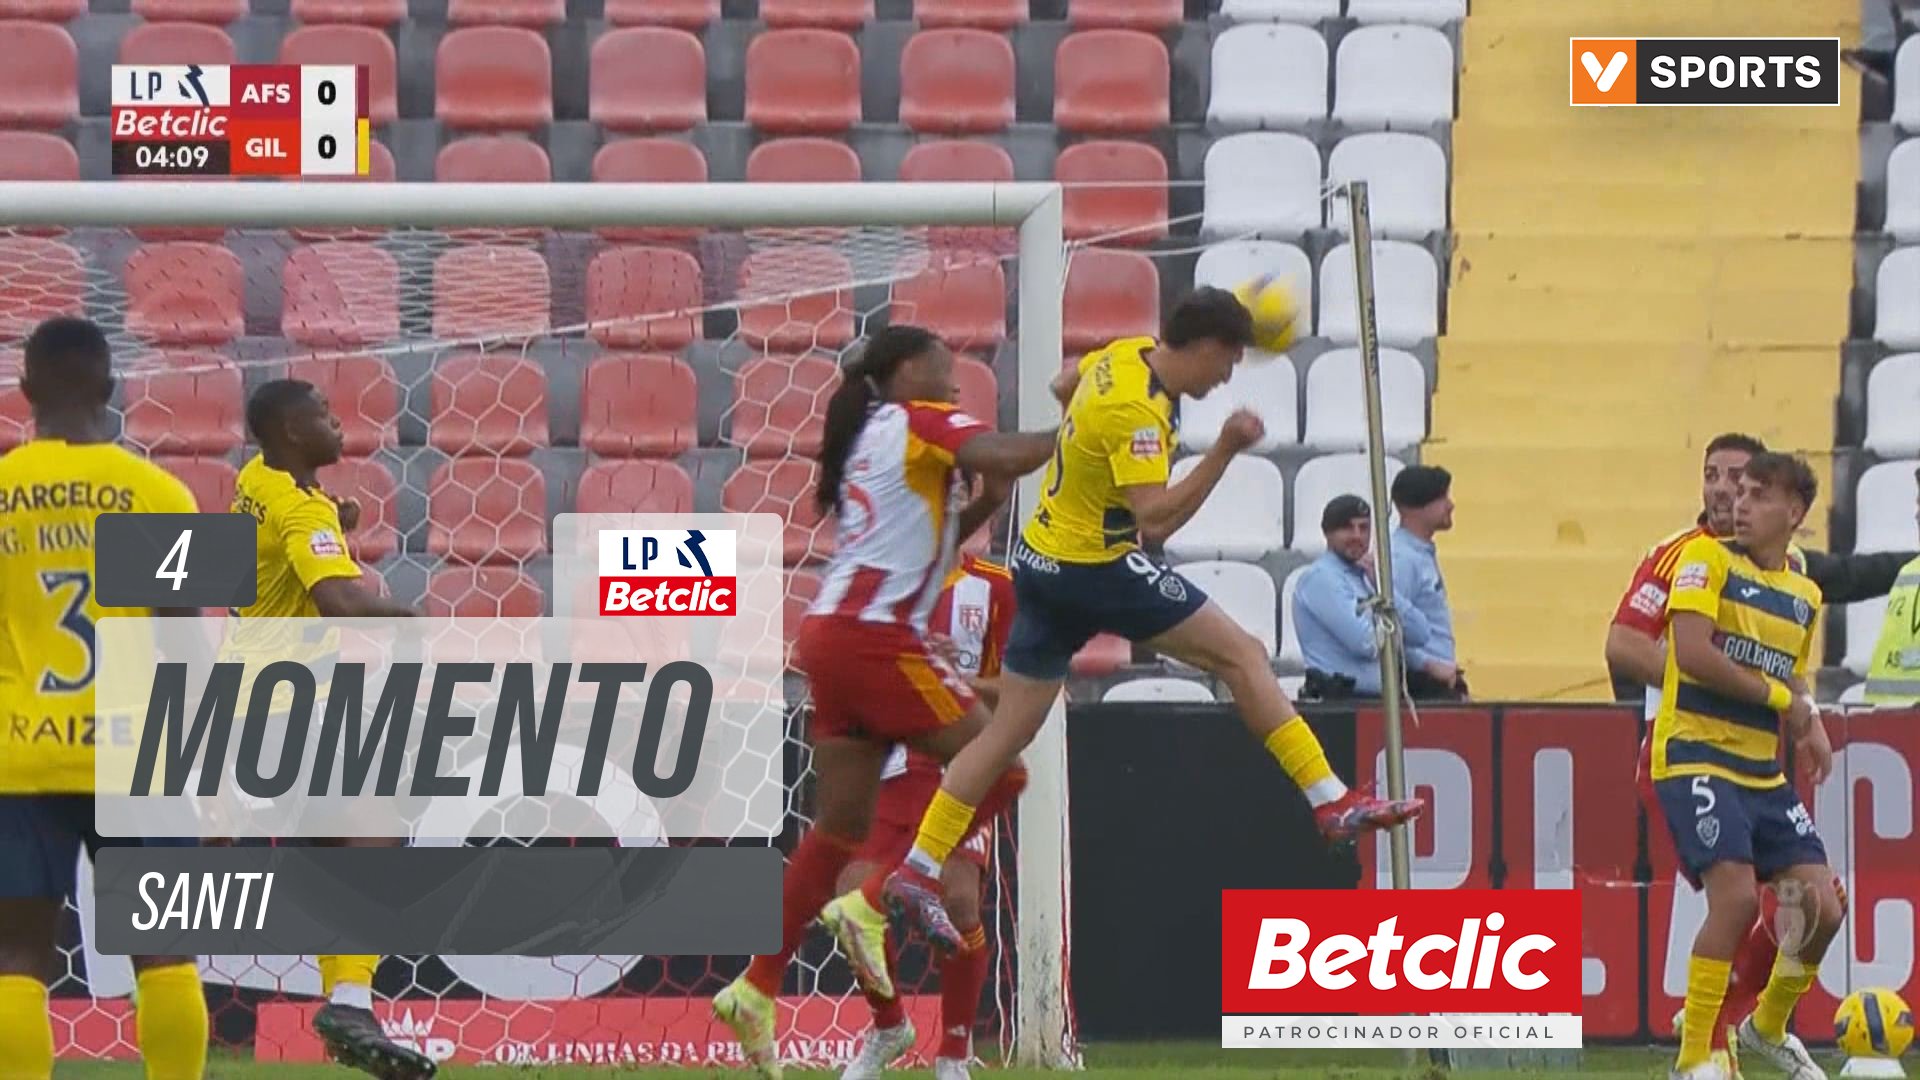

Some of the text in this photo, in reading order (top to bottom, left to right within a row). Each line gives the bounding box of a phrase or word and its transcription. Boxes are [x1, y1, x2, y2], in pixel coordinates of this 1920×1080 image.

[37, 569, 103, 696] 3
[8, 713, 136, 748] RAIZE
[1692, 775, 1716, 816] 5
[660, 1041, 699, 1063] DA
[707, 1040, 864, 1062] PRAVER
